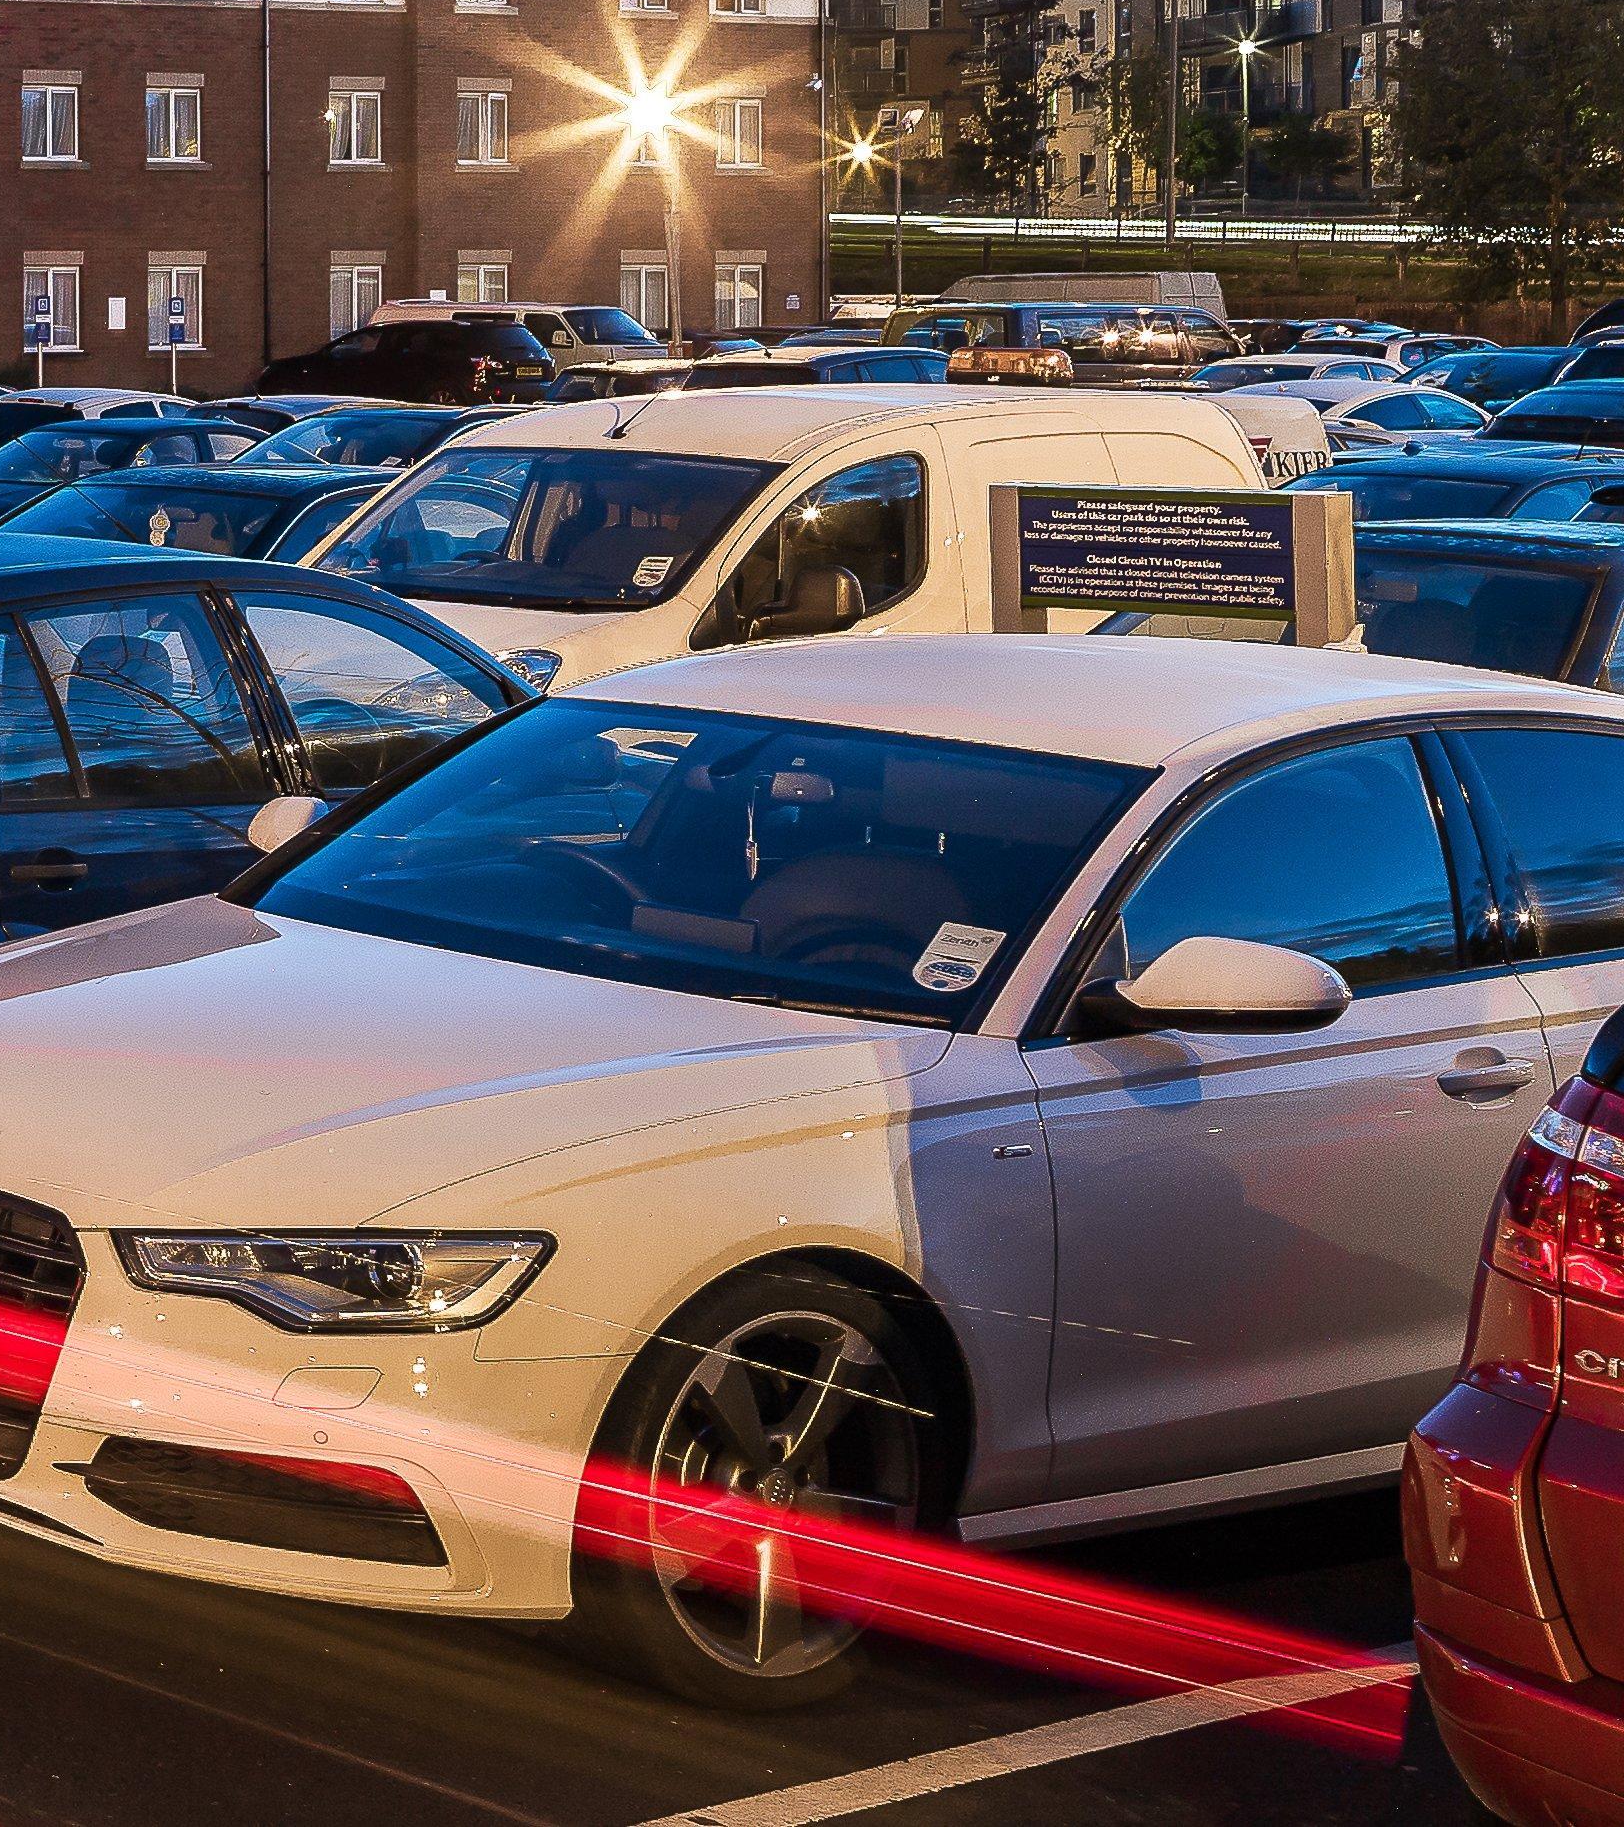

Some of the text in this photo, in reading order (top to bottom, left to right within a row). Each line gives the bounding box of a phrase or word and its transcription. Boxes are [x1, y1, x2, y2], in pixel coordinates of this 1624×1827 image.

[1273, 450, 1327, 477] KIER
[1077, 501, 1222, 515] Please safeguard your property.
[1052, 511, 1076, 519] Users
[1078, 511, 1087, 519] of
[1089, 512, 1106, 520] this
[1123, 514, 1144, 522] park
[1146, 514, 1157, 522] do
[1183, 515, 1205, 523] their
[1229, 517, 1249, 525] risk.
[1032, 521, 1047, 529] The
[1049, 522, 1093, 531] proprietors
[1094, 524, 1120, 533] accept
[1135, 526, 1190, 536] responsibility
[1192, 528, 1240, 536] whatsoever
[1242, 529, 1254, 537] for
[1256, 531, 1272, 539] any
[1051, 532, 1083, 542] damage
[1095, 534, 1127, 542] vehicles
[1163, 537, 1200, 547] property
[1201, 538, 1247, 547] howsoever
[1249, 540, 1282, 549] caused.
[1087, 555, 1116, 564] Closed
[1118, 556, 1147, 565] Circuit
[1174, 558, 1222, 569] Operation
[1068, 567, 1098, 575] advised
[1100, 568, 1116, 576] that
[1125, 569, 1150, 577] closed
[1180, 571, 1219, 580] television
[1221, 574, 1252, 582] camera
[1254, 574, 1284, 583] system
[1039, 575, 1066, 584] (CCTV)
[1085, 579, 1124, 587] operation
[1135, 580, 1157, 588] these
[1160, 581, 1198, 590] premises.
[1201, 583, 1233, 593] Images
[1249, 585, 1274, 595] being
[1031, 586, 1065, 594] recorded
[1067, 586, 1078, 594] for
[1080, 587, 1093, 595] the
[1095, 589, 1128, 597] purpose
[1129, 589, 1138, 598] of
[1165, 592, 1210, 601] prevention
[1212, 594, 1228, 602] and
[1230, 595, 1256, 603] public
[1258, 595, 1285, 606] safety.
[1573, 1349, 1624, 1379] CI
